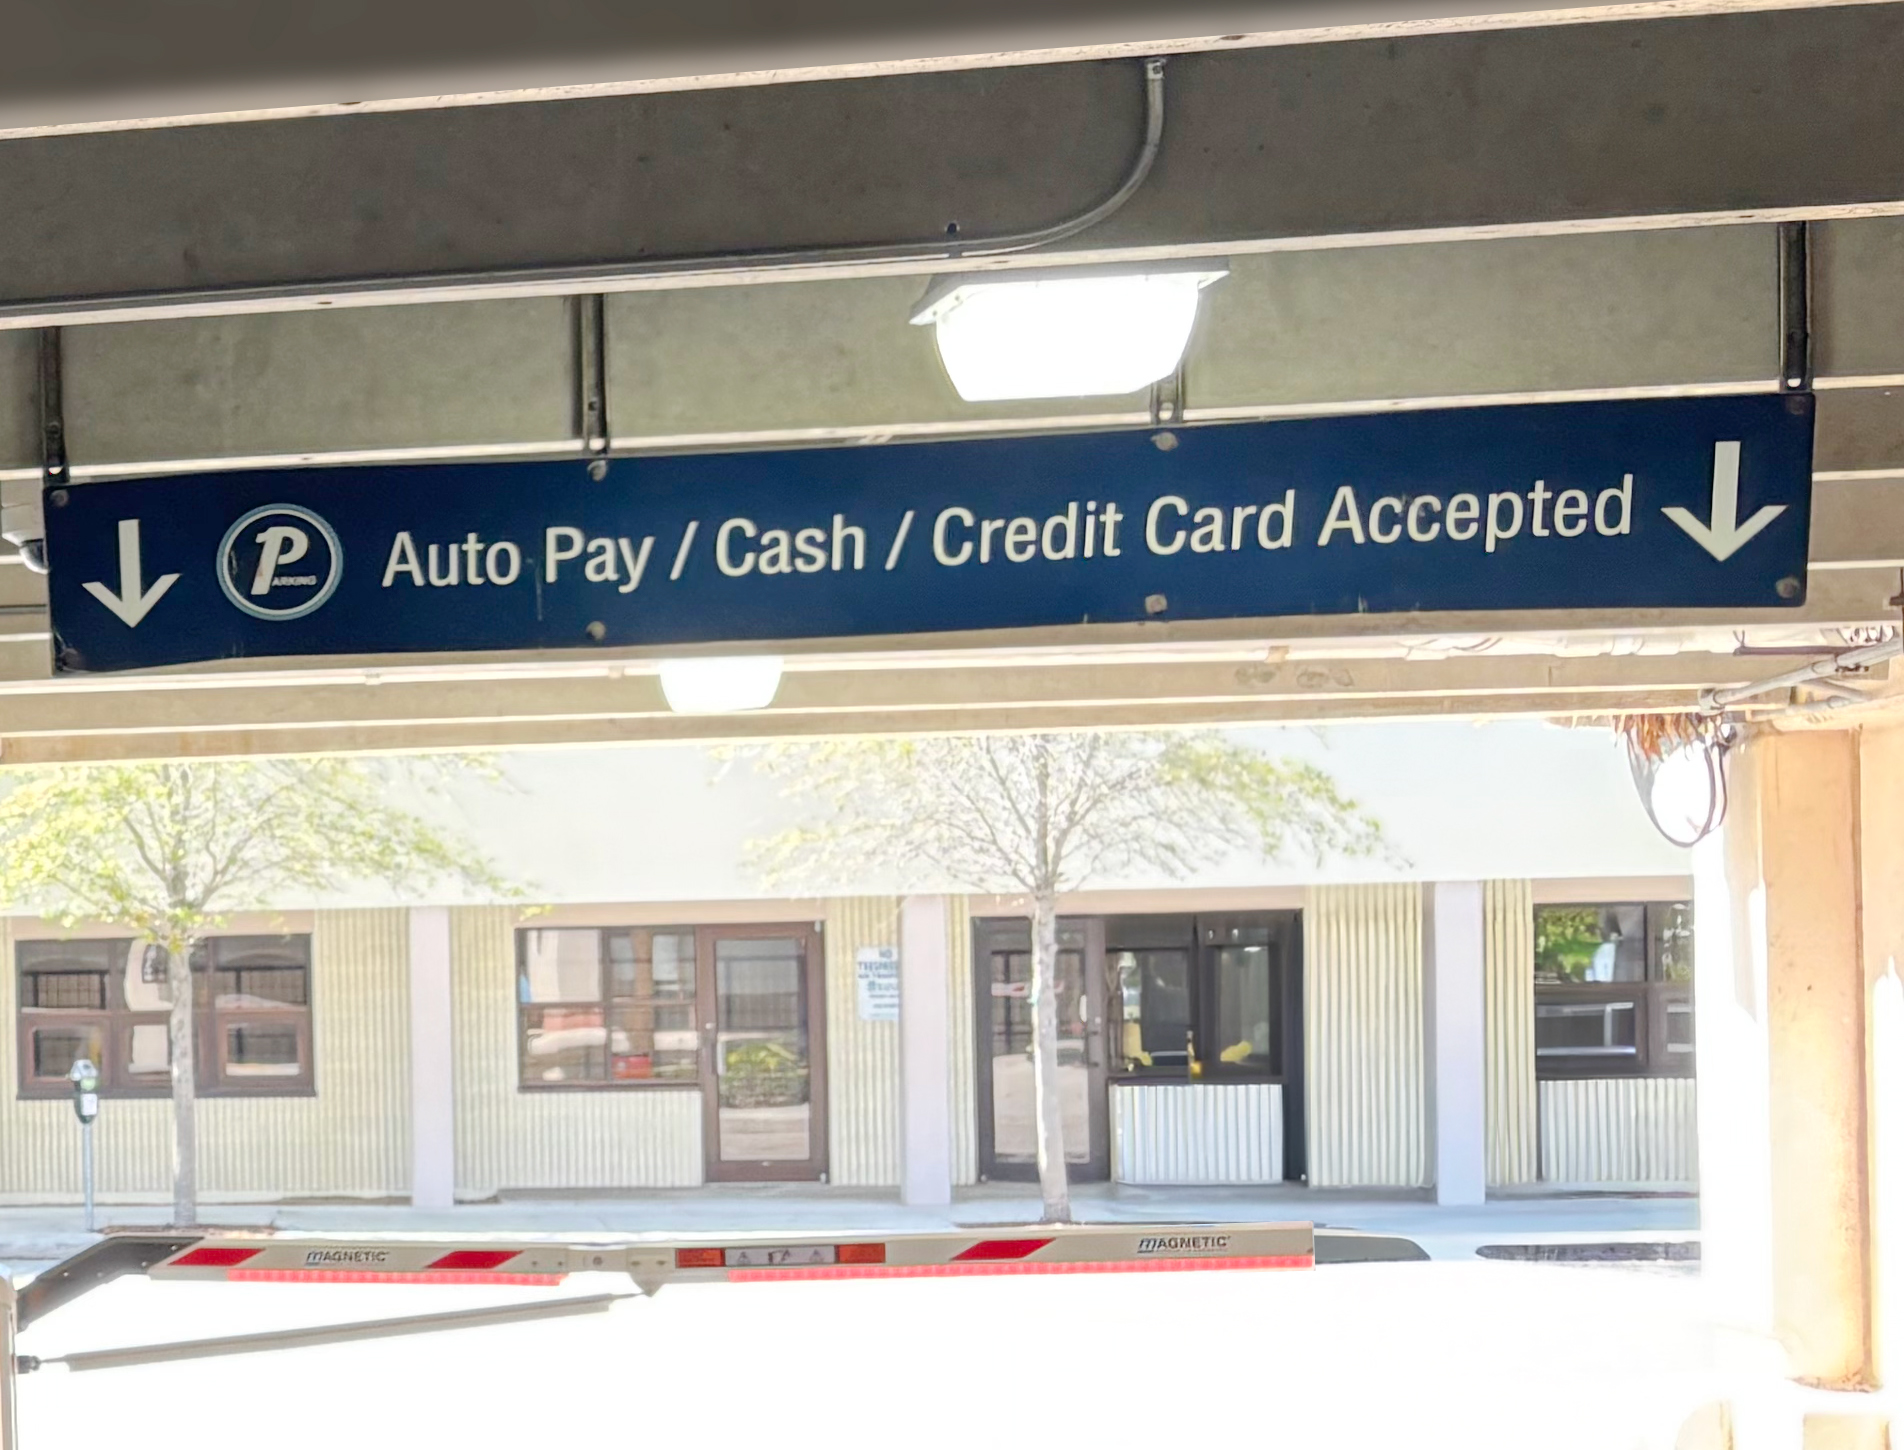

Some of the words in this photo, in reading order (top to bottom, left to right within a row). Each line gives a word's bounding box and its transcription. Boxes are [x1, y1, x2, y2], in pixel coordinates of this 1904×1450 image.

[382, 532, 521, 587] Auto
[545, 527, 655, 594] Pay
[669, 520, 699, 581] /
[716, 513, 865, 577] Cash
[884, 510, 915, 571] /
[933, 500, 1124, 567] Credit
[1145, 490, 1296, 556] Card
[1317, 473, 1634, 553] Accepted
